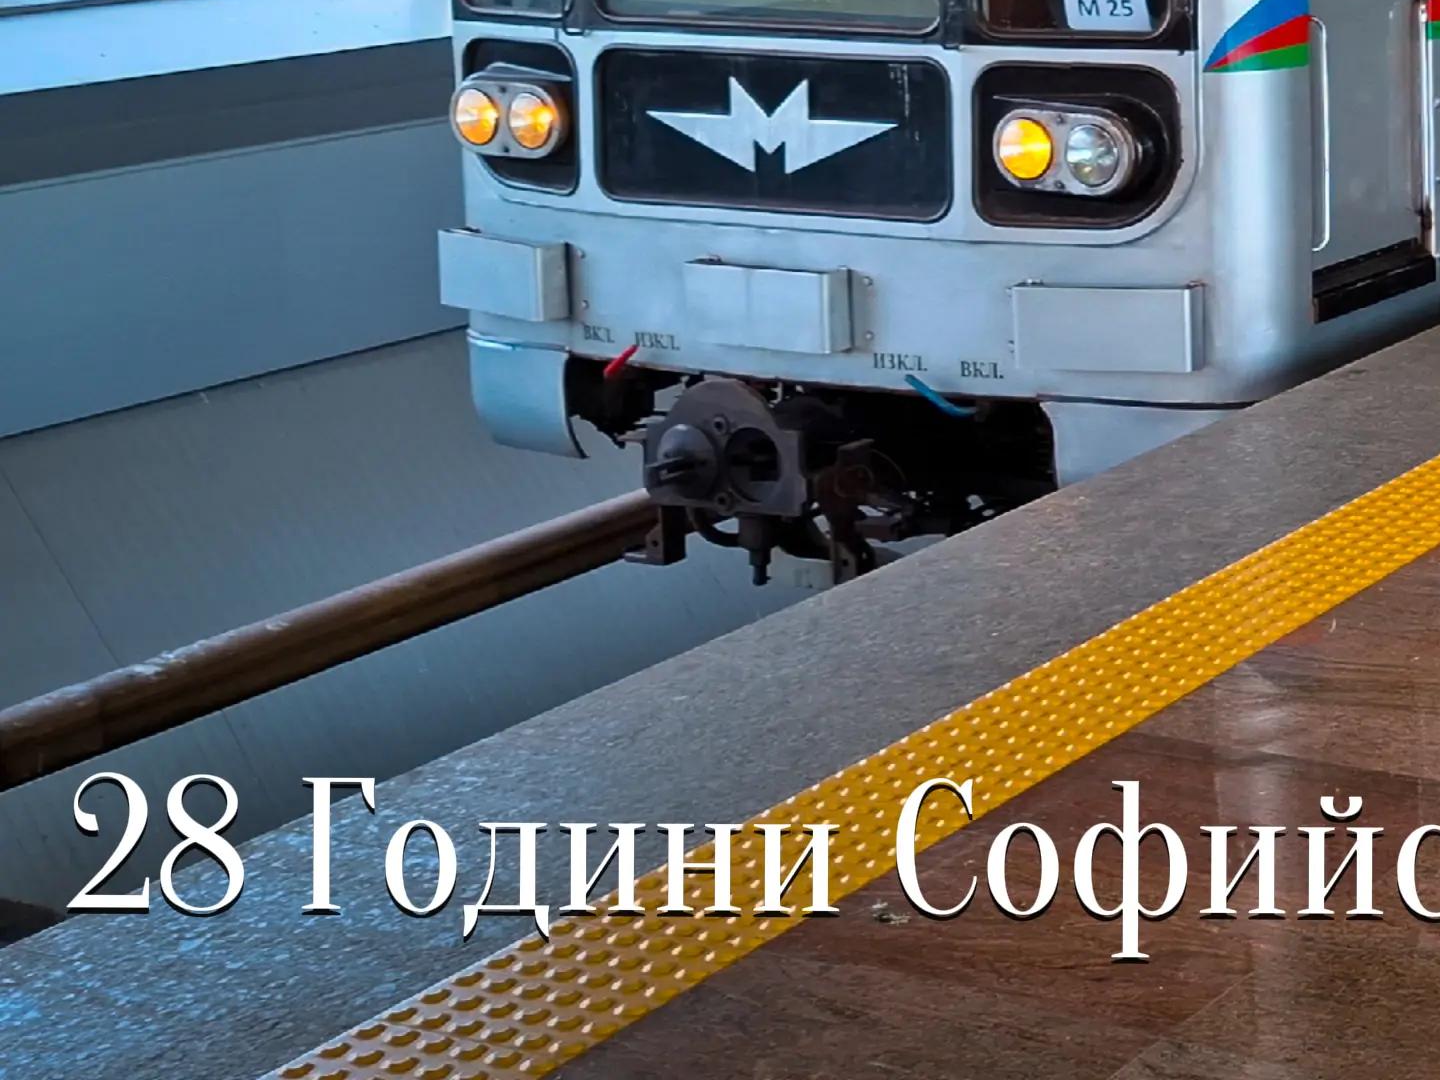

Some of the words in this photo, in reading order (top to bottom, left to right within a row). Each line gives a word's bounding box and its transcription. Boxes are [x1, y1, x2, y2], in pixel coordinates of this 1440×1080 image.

[1106, 0, 1134, 17] 25
[873, 352, 928, 372] ИЗКЛ.
[960, 360, 1004, 379] ВКЛ.
